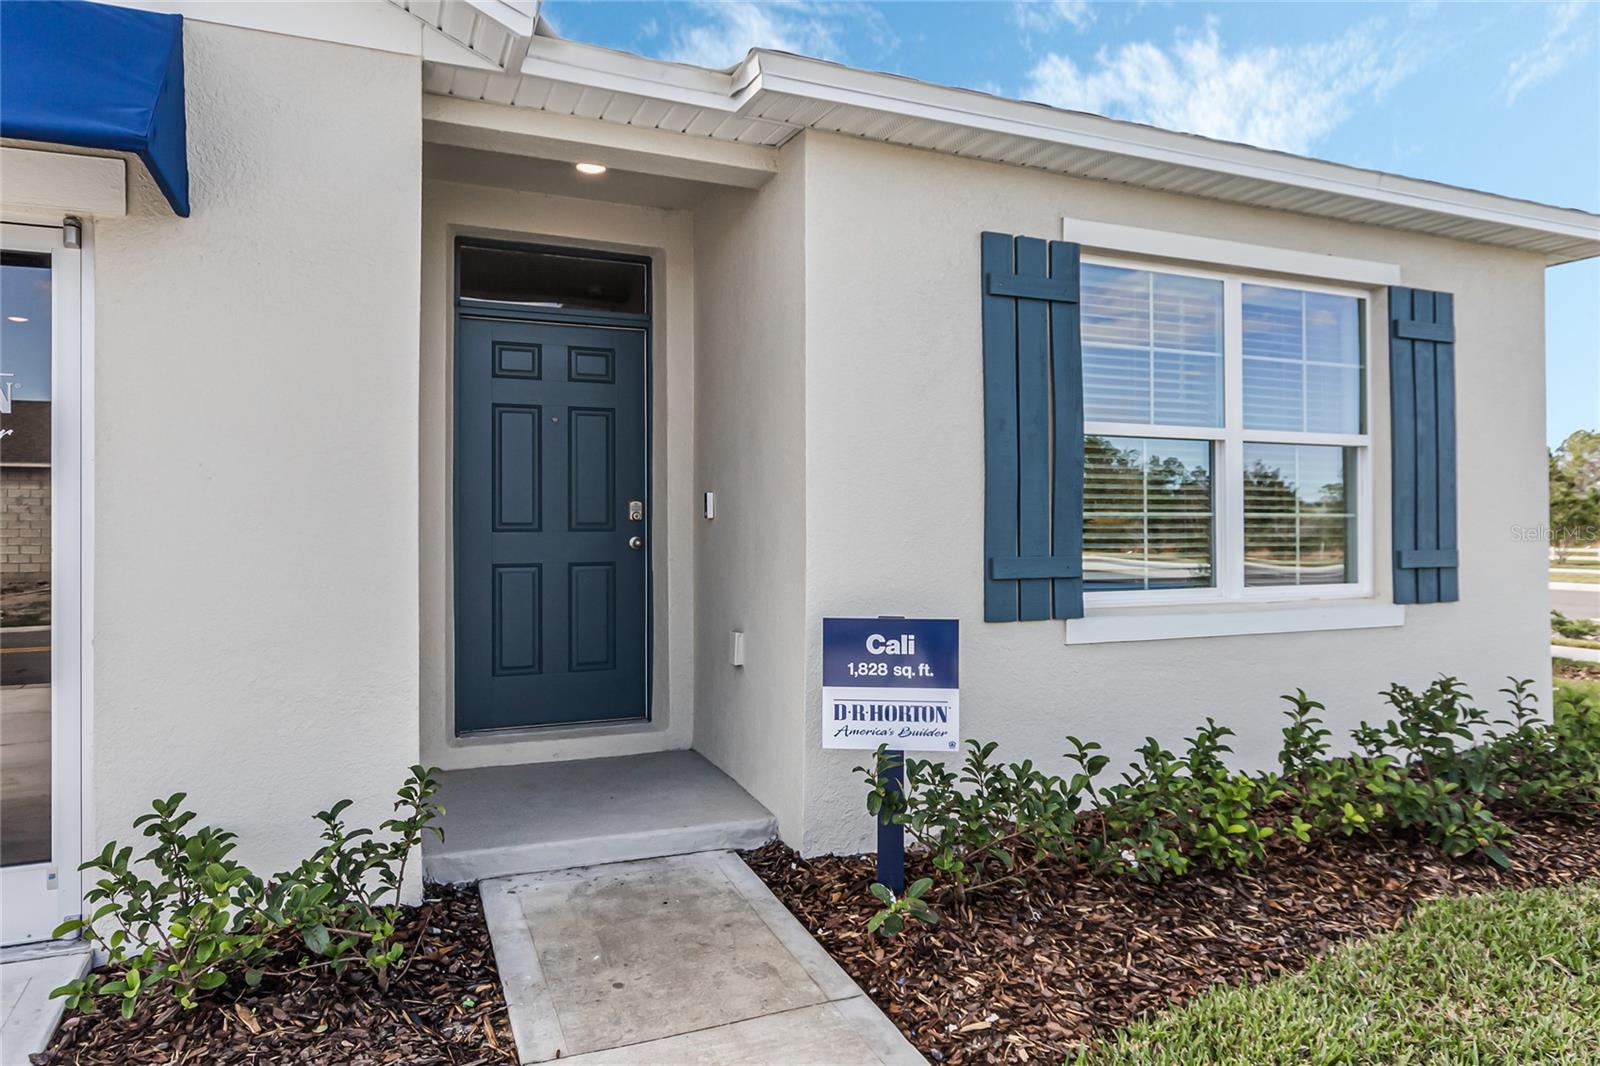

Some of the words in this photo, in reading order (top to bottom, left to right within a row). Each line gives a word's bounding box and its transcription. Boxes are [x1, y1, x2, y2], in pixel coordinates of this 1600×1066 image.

[865, 633, 915, 655] Cali
[847, 662, 888, 678] 1,828
[893, 665, 916, 679] sq.
[918, 663, 934, 677] ft.
[833, 725, 894, 738] America's
[897, 727, 948, 738] Builder
